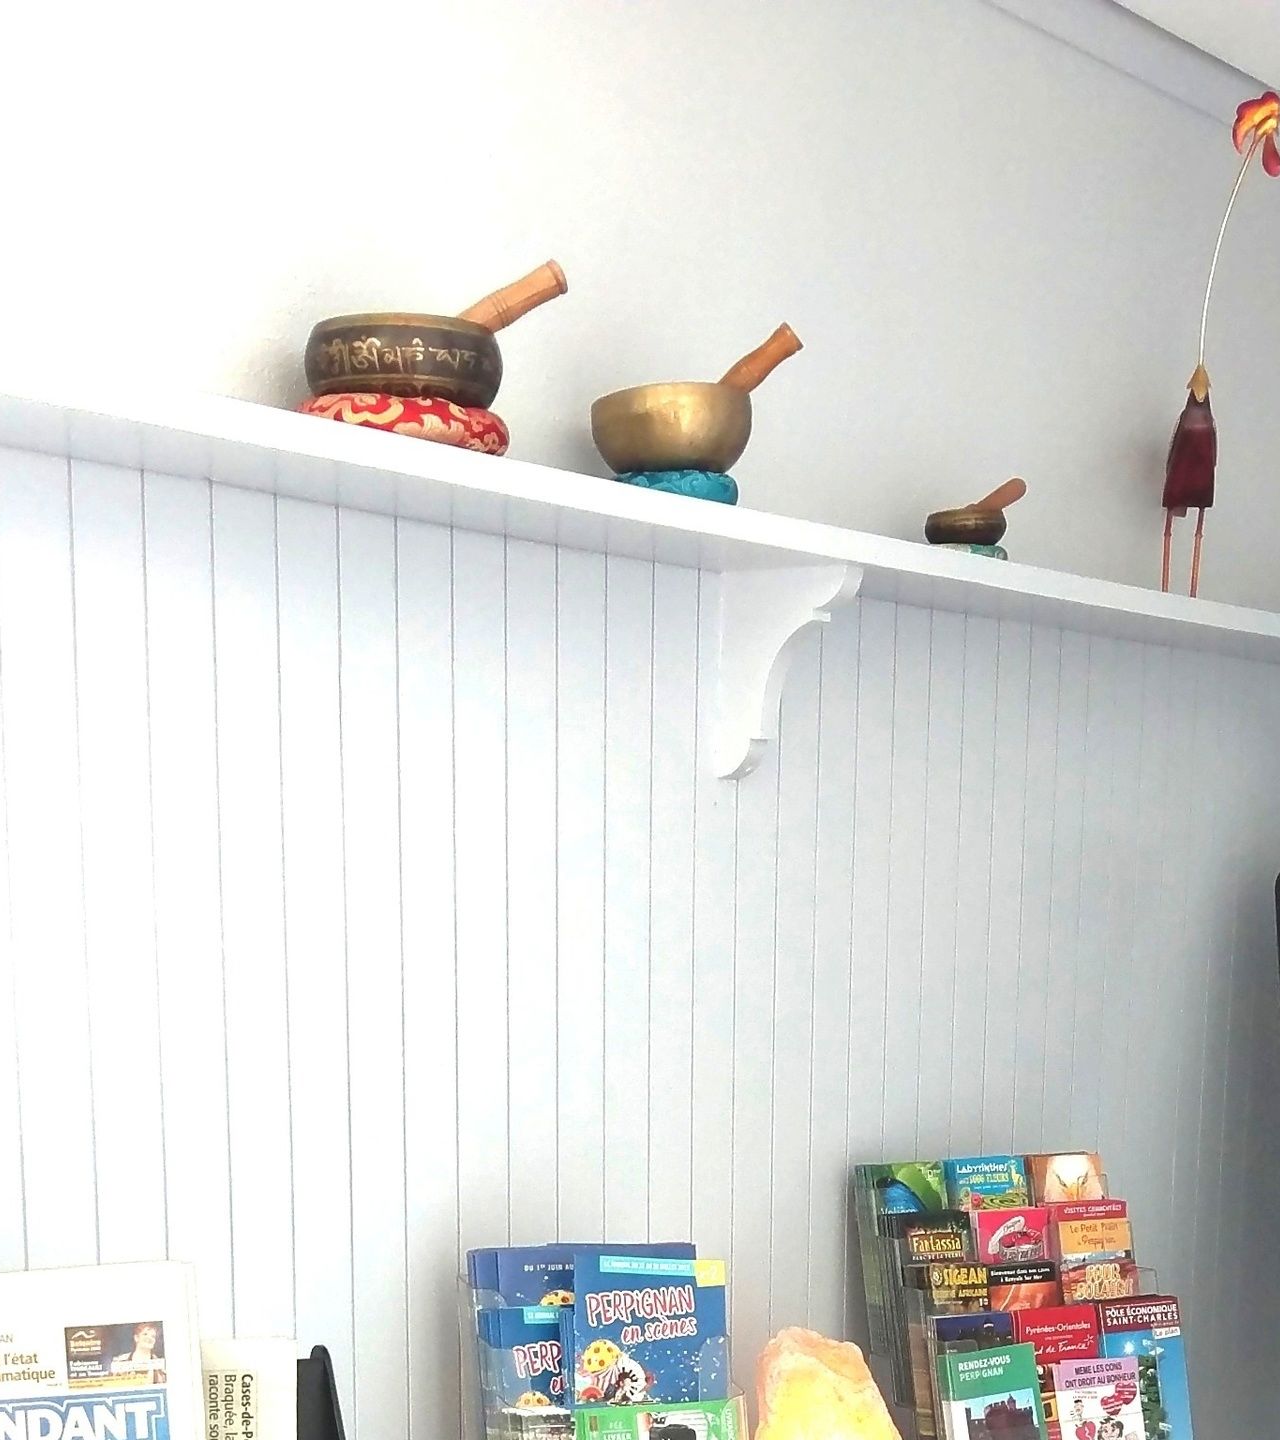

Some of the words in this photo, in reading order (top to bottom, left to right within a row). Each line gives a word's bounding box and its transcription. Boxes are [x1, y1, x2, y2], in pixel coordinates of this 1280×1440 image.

[1105, 1306, 1125, 1319] PÔLE
[3, 1352, 39, 1366] l'état
[958, 1355, 1011, 1372] RENDEZ-VOUS
[208, 1373, 220, 1421] raconte
